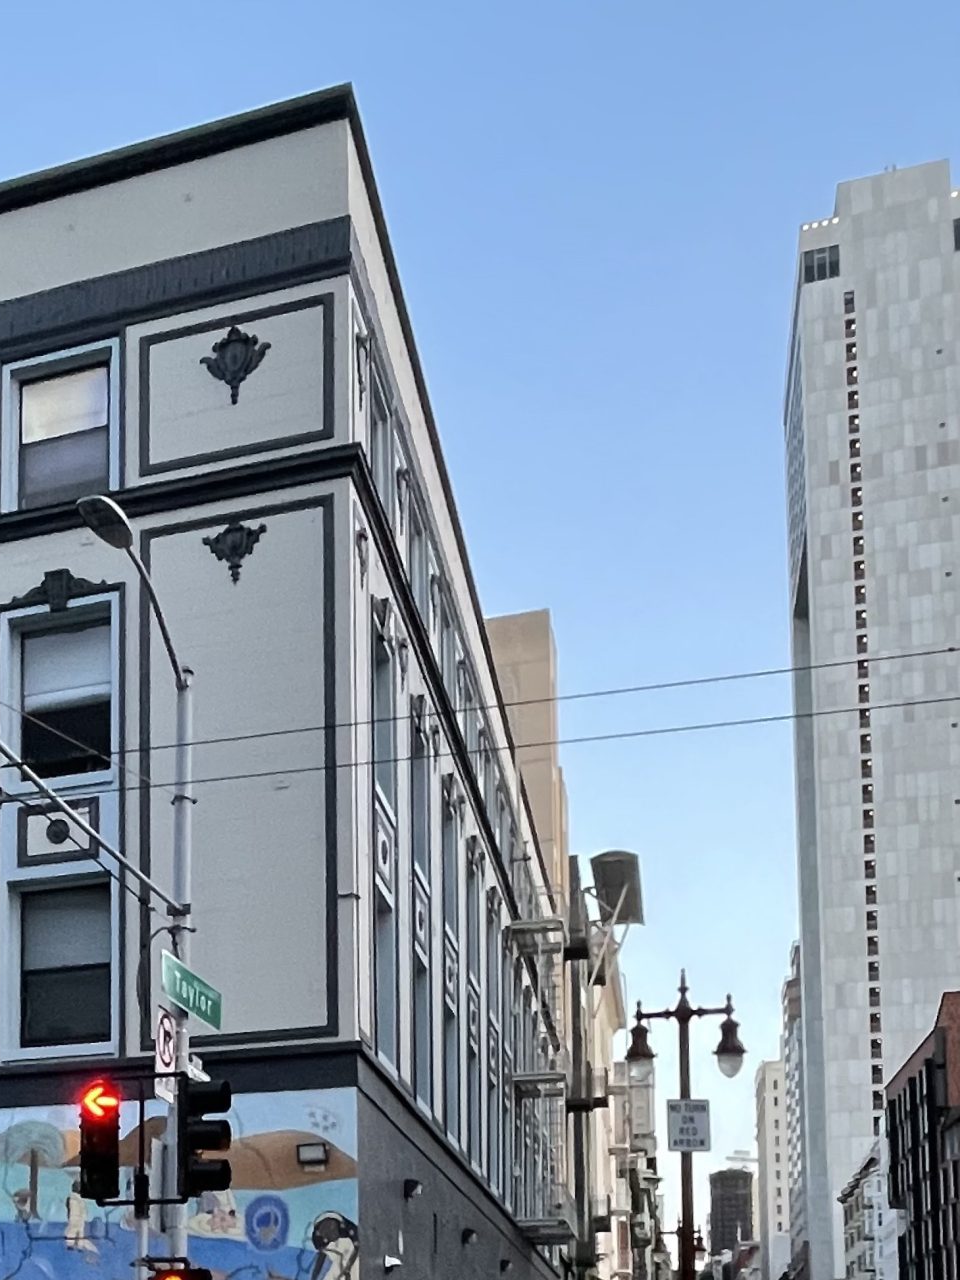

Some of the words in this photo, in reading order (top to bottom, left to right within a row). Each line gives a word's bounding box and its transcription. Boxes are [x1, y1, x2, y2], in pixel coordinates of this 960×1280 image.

[174, 969, 213, 1017] Taylor
[669, 1103, 682, 1113] NO
[684, 1102, 707, 1113] TURN
[681, 1115, 695, 1125] ON
[678, 1126, 698, 1136] RED
